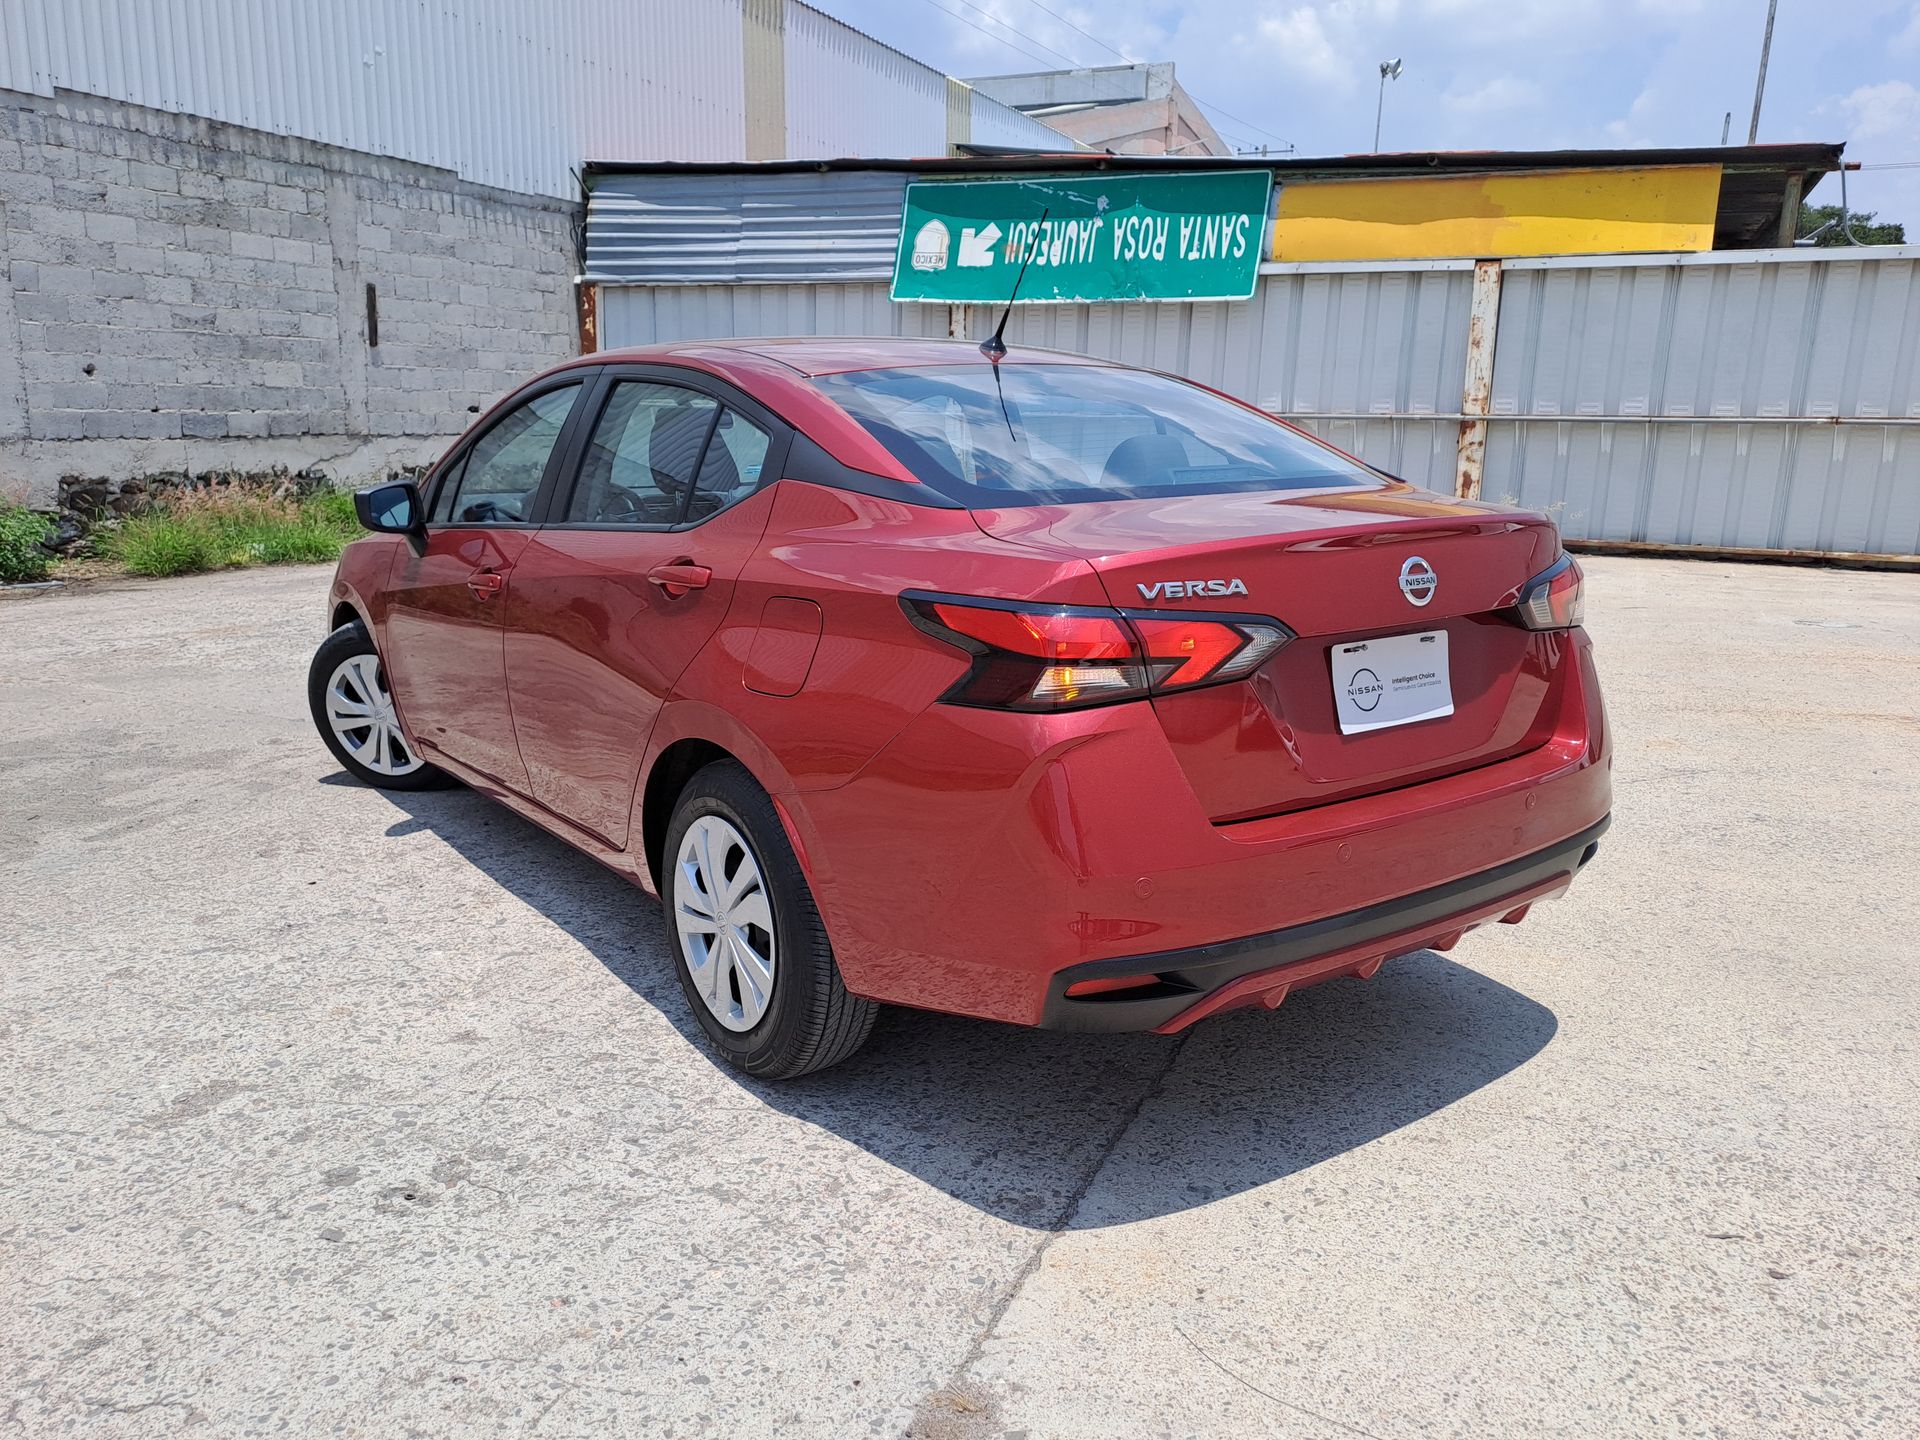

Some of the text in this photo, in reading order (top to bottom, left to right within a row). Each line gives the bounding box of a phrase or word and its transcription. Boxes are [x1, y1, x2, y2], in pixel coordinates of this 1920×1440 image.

[1113, 215, 1169, 260] ROSA
[1179, 214, 1250, 259] SANTA
[915, 254, 945, 265] MEXICO
[1405, 576, 1436, 586] NISSAN
[1136, 578, 1249, 600] VERSA
[1391, 672, 1436, 684] Intelligent Choice
[1347, 684, 1384, 696] NISSAN
